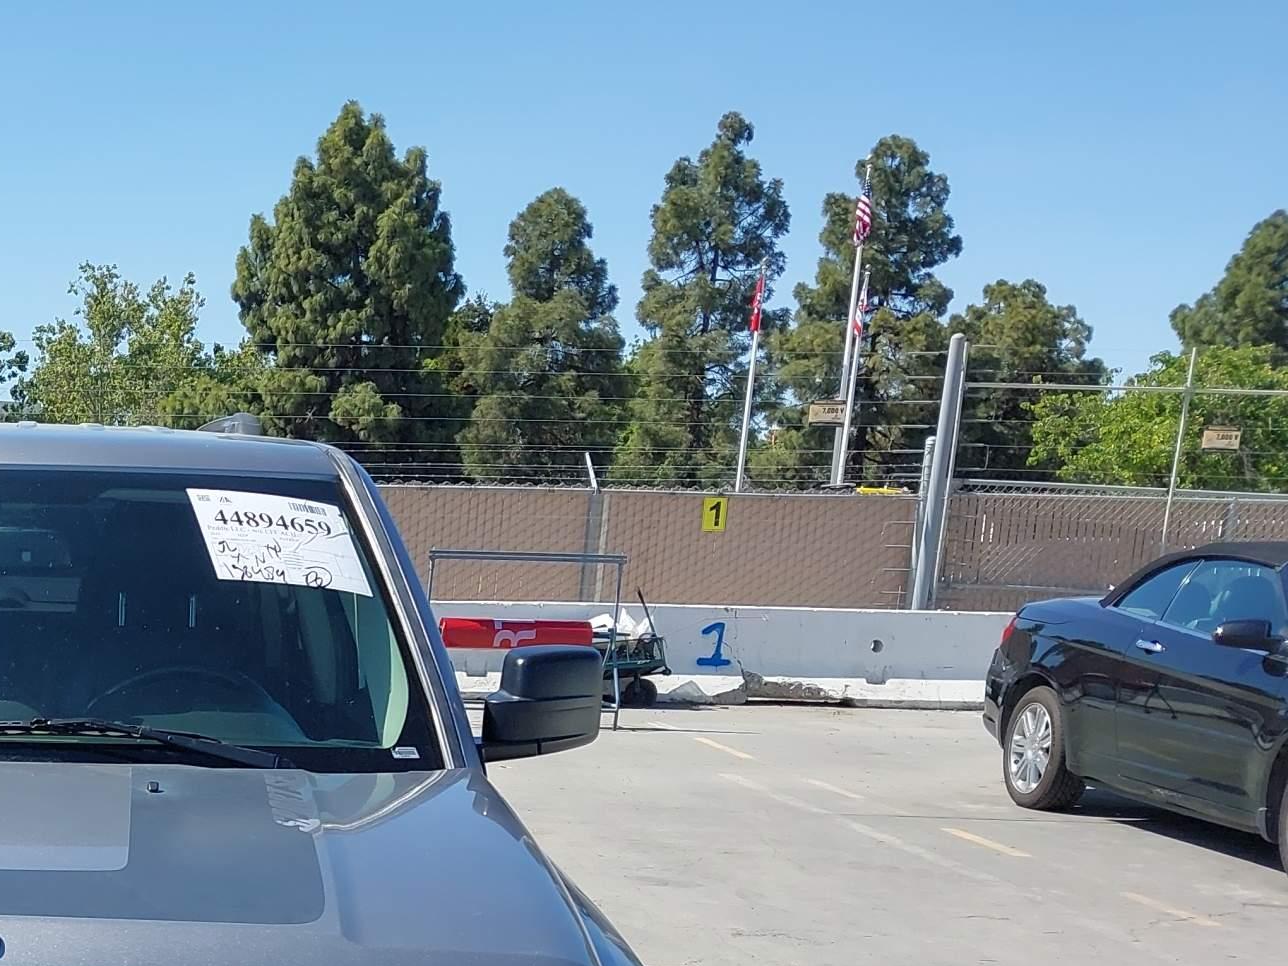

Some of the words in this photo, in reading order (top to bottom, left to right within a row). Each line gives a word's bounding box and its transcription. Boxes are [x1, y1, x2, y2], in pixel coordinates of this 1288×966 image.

[214, 508, 332, 537] 44894659
[709, 500, 722, 527] 1
[696, 622, 731, 668] 1
